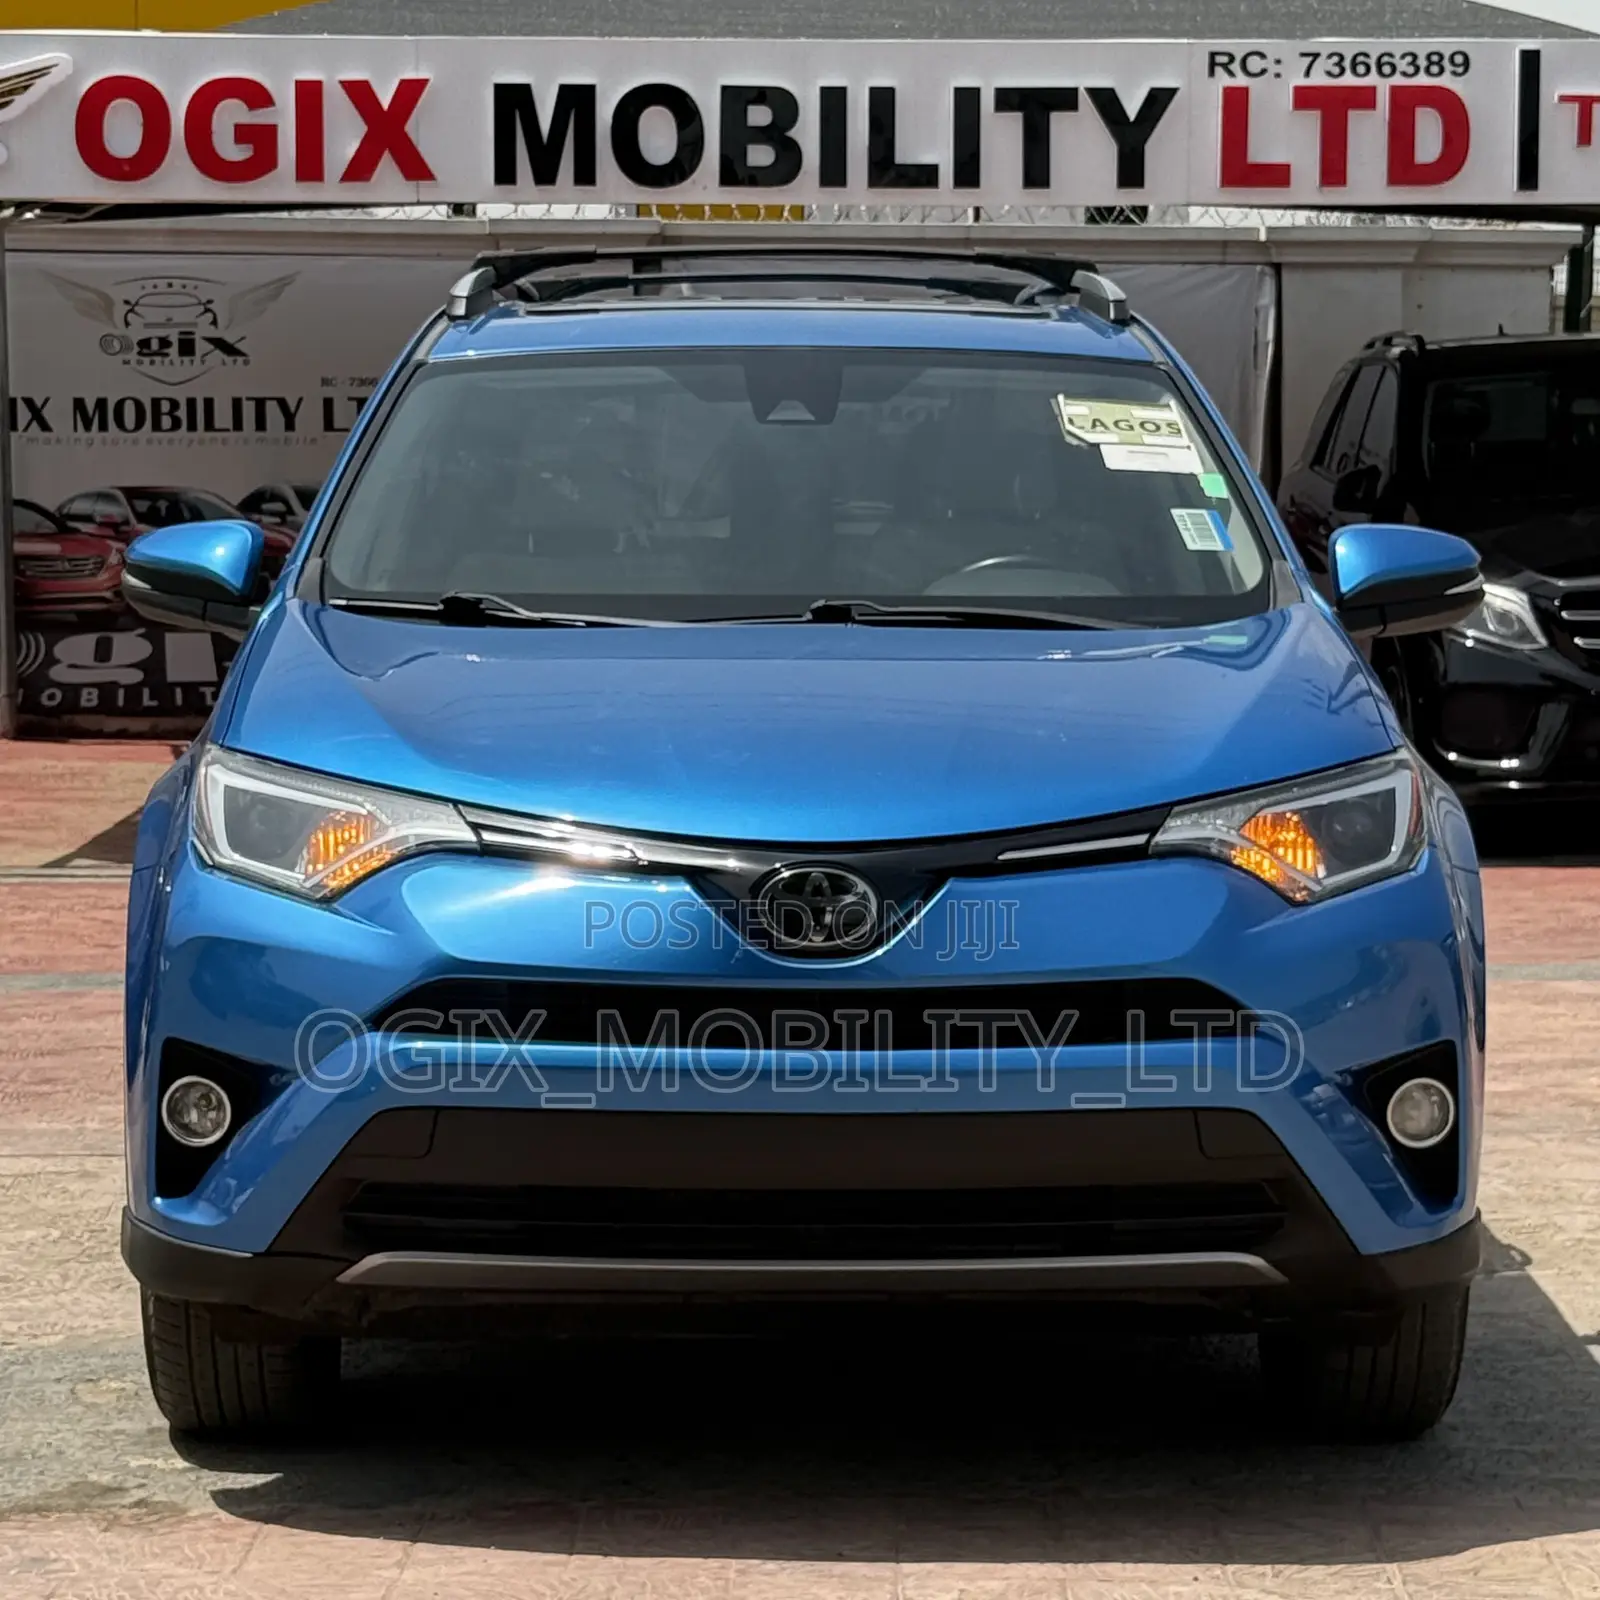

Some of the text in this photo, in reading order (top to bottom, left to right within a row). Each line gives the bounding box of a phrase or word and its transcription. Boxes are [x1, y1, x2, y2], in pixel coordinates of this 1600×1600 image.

[1207, 50, 1471, 78] RC: 7366389
[74, 74, 1470, 189] OGIX MOBILITY LTD
[73, 396, 304, 432] MOBILITY
